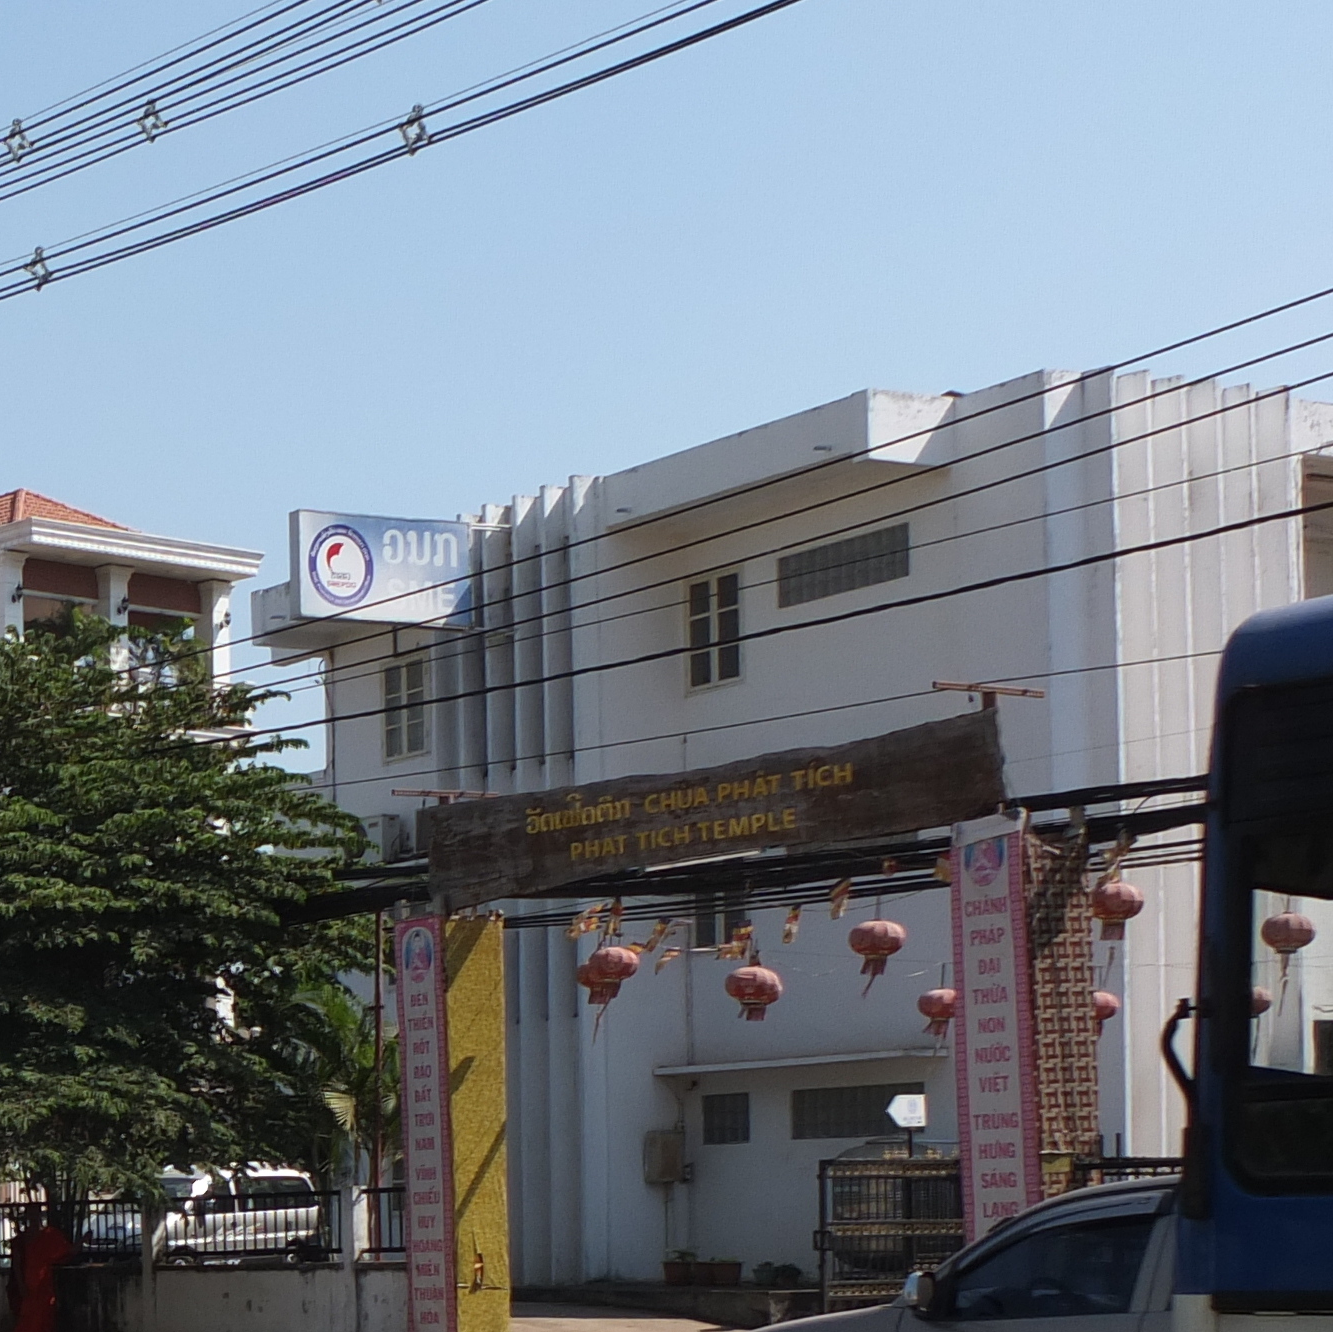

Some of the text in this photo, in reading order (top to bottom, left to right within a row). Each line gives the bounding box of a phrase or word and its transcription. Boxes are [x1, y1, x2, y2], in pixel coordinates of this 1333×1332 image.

[387, 577, 457, 613] SME
[570, 808, 796, 861] PHAT TICH TEMPLE
[969, 923, 1005, 946] PHÁP
